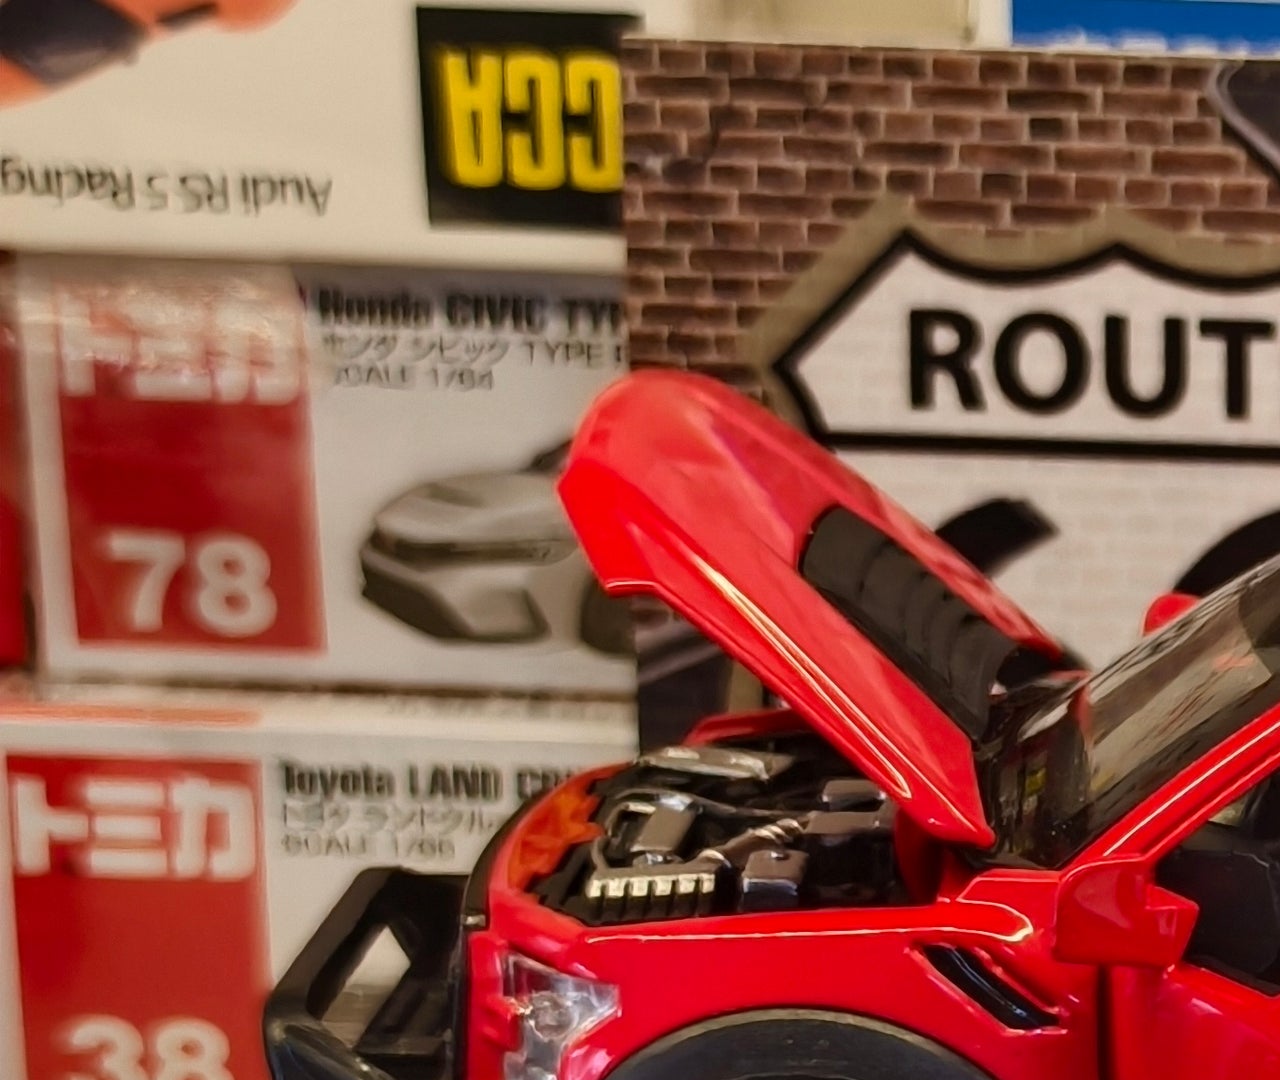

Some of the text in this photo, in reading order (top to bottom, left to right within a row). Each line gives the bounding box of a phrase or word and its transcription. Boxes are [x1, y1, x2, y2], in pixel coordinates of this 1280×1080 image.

[444, 52, 621, 191] CCA
[0, 157, 332, 217] Audi RS 5 Racing
[524, 340, 604, 367] TYPE
[108, 530, 278, 635] 78
[282, 764, 395, 800] Toyota
[408, 765, 503, 800] LAND
[15, 778, 256, 880] トミカ
